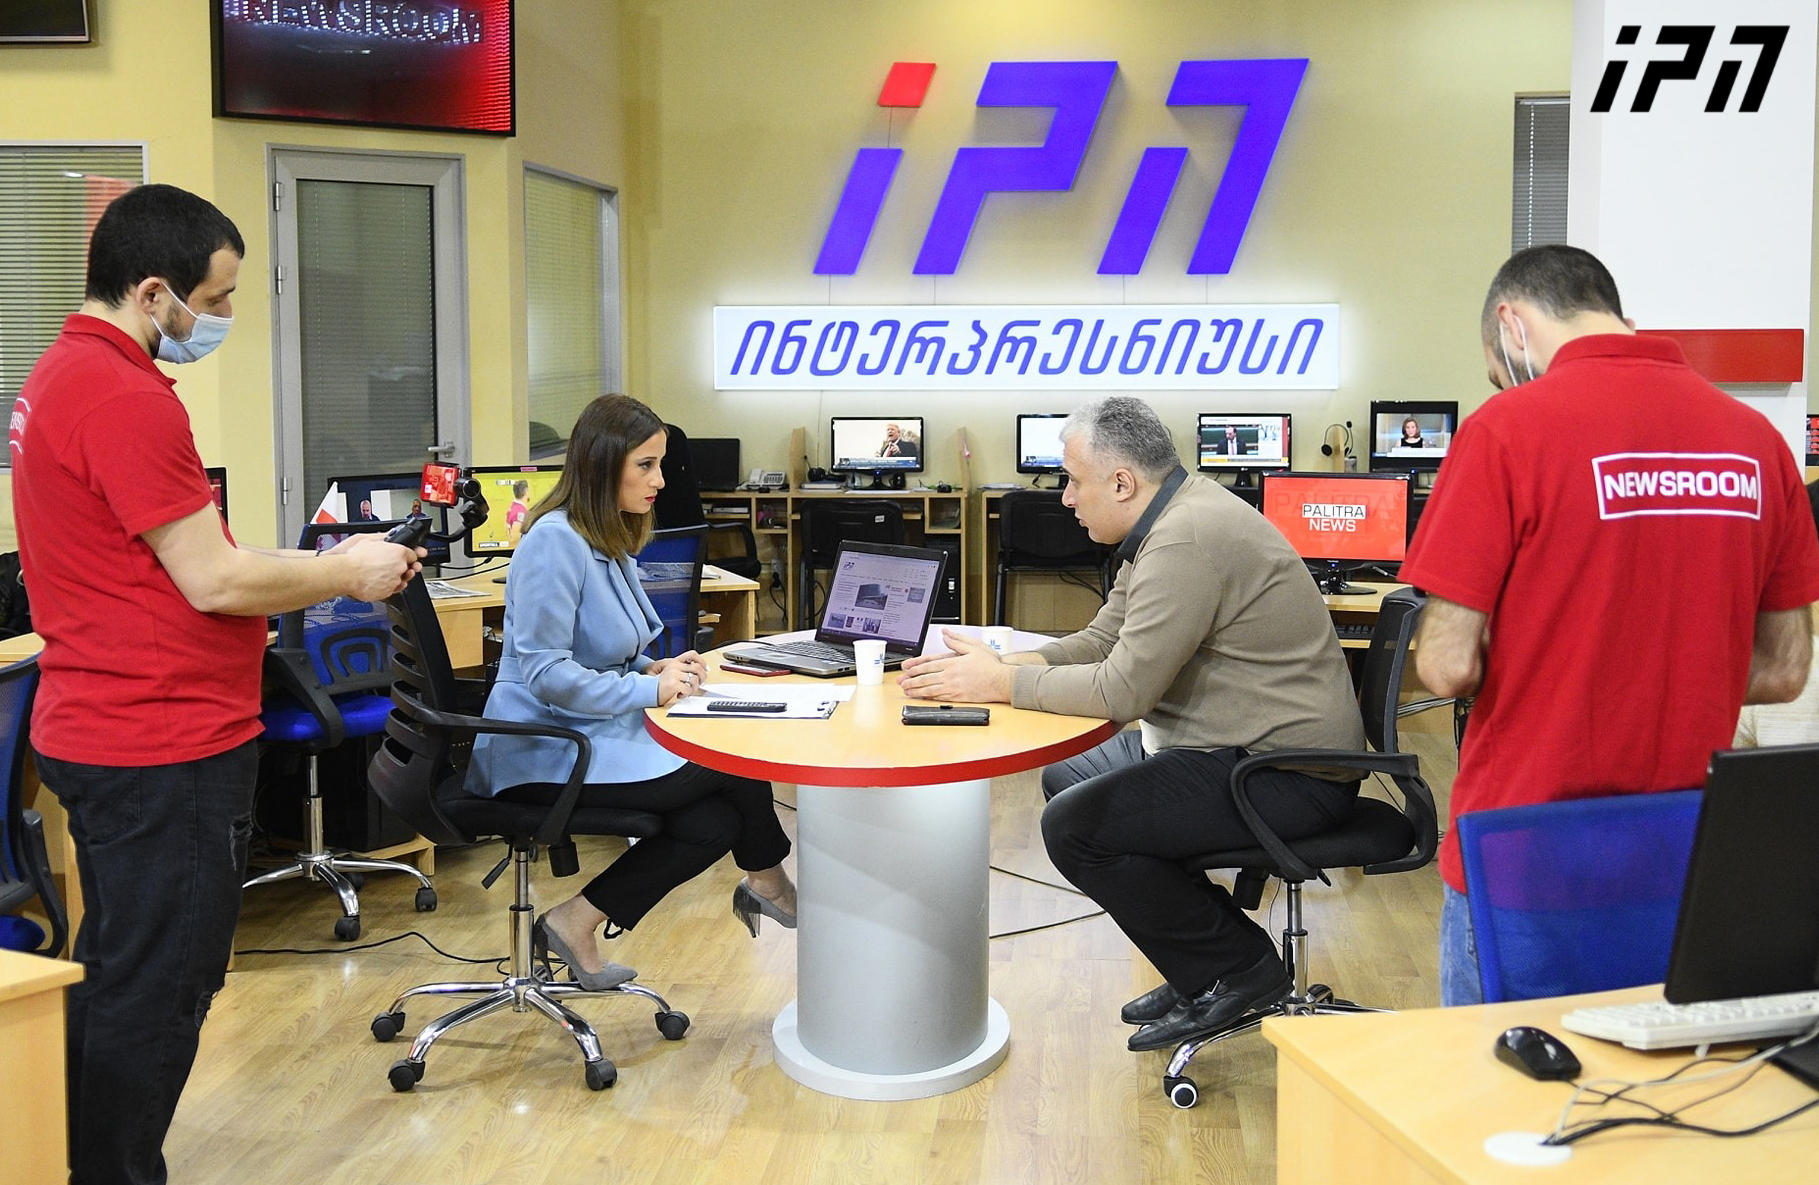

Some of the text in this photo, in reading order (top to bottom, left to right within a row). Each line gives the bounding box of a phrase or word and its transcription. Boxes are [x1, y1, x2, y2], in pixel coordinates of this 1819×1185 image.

[1603, 471, 1757, 500] NEWSROOM
[1302, 504, 1365, 518] PALITRA
[1308, 519, 1357, 533] NEWS
